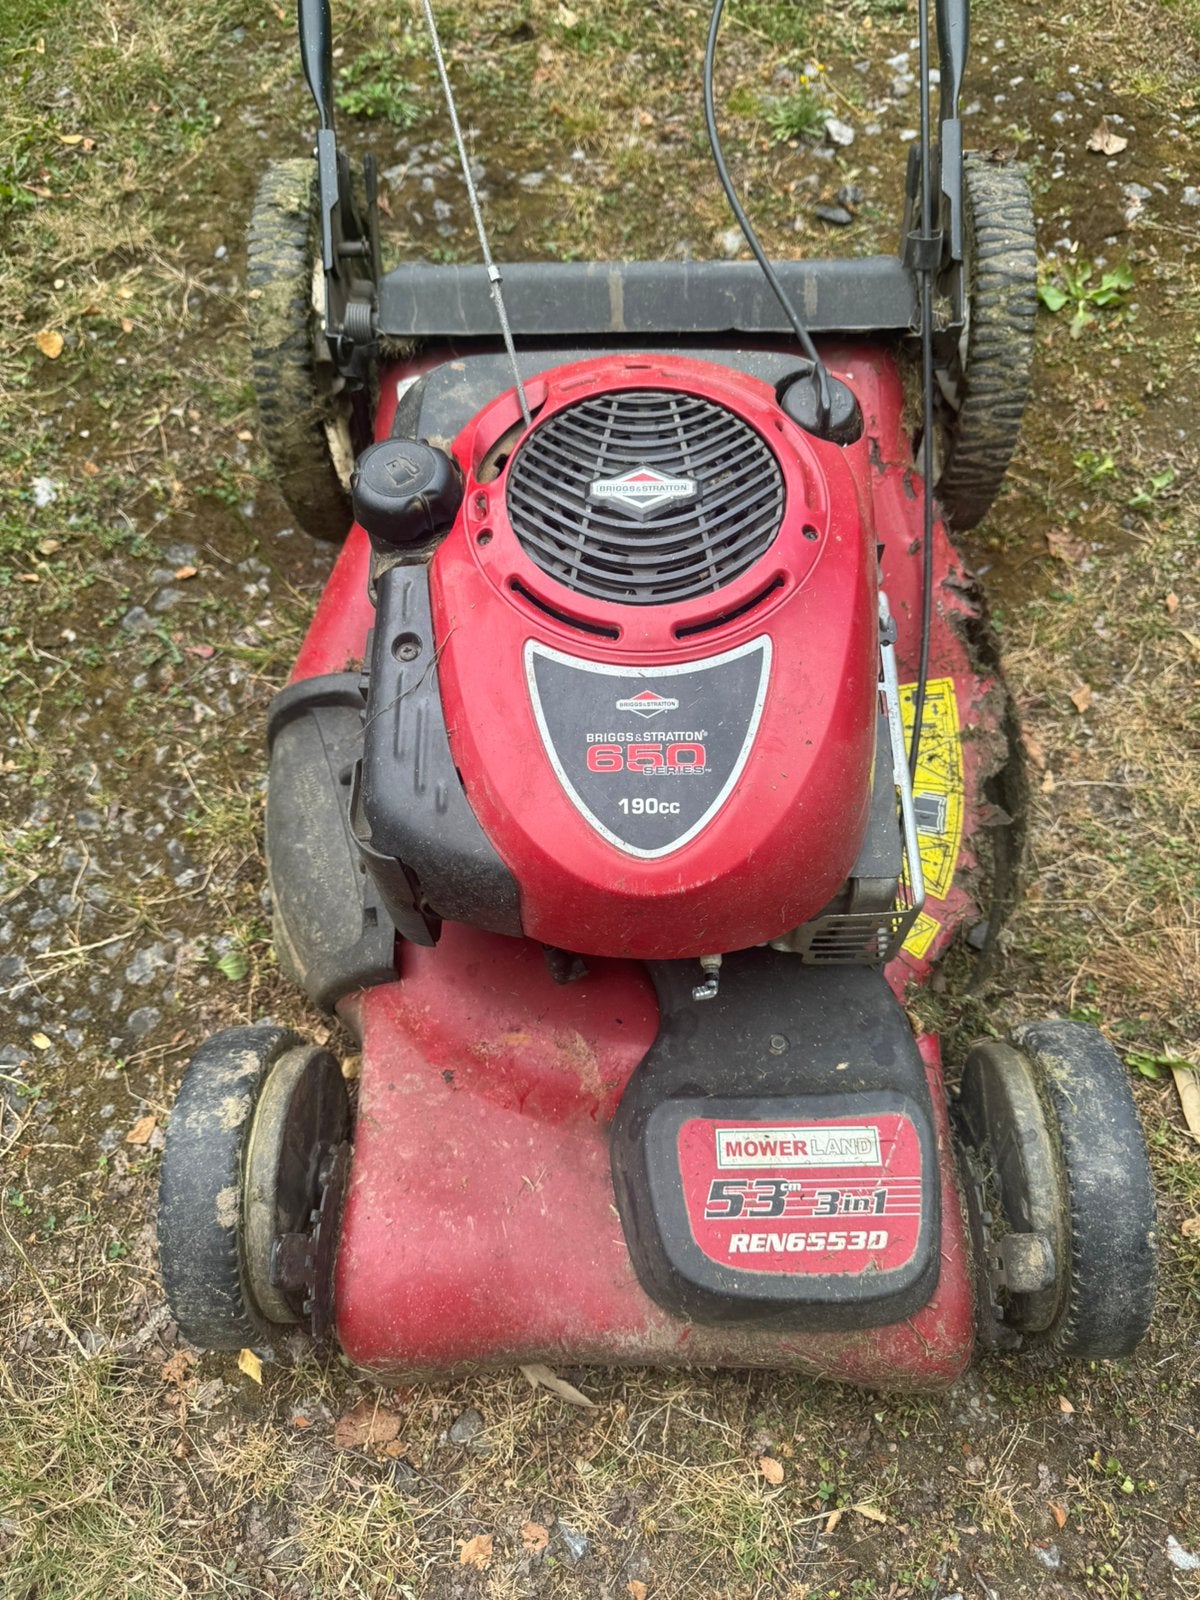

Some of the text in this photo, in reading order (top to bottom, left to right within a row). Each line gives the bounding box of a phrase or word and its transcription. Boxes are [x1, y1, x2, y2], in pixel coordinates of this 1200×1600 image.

[586, 743, 706, 773] 650
[618, 798, 680, 814] 190cc
[728, 1230, 889, 1254] REN6553D
